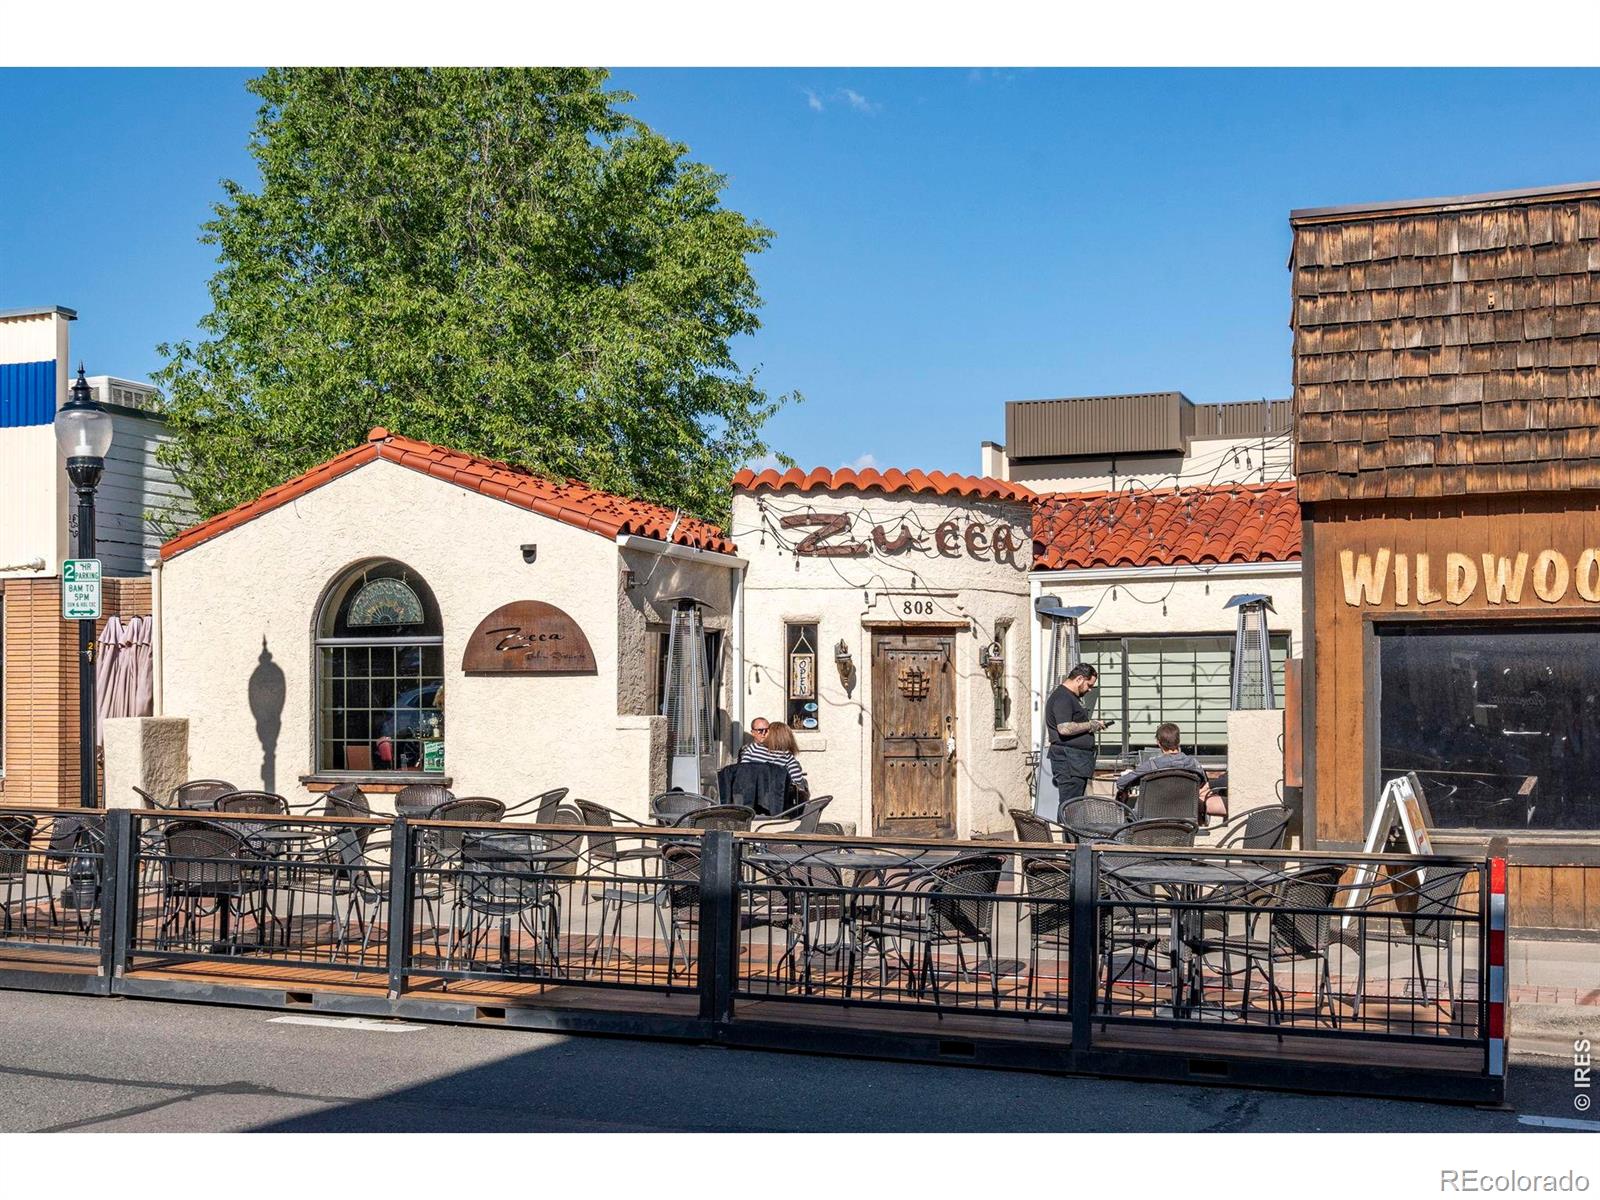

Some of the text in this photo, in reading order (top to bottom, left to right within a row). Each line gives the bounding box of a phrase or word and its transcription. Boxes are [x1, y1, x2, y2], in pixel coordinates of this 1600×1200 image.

[780, 512, 1026, 564] Zucca
[64, 563, 92, 579] 2 HR
[75, 572, 99, 580] PARKING
[1340, 547, 1600, 607] WILDWOO
[69, 585, 83, 593] 8AM
[903, 600, 934, 616] 808
[799, 660, 807, 695] OPEN
